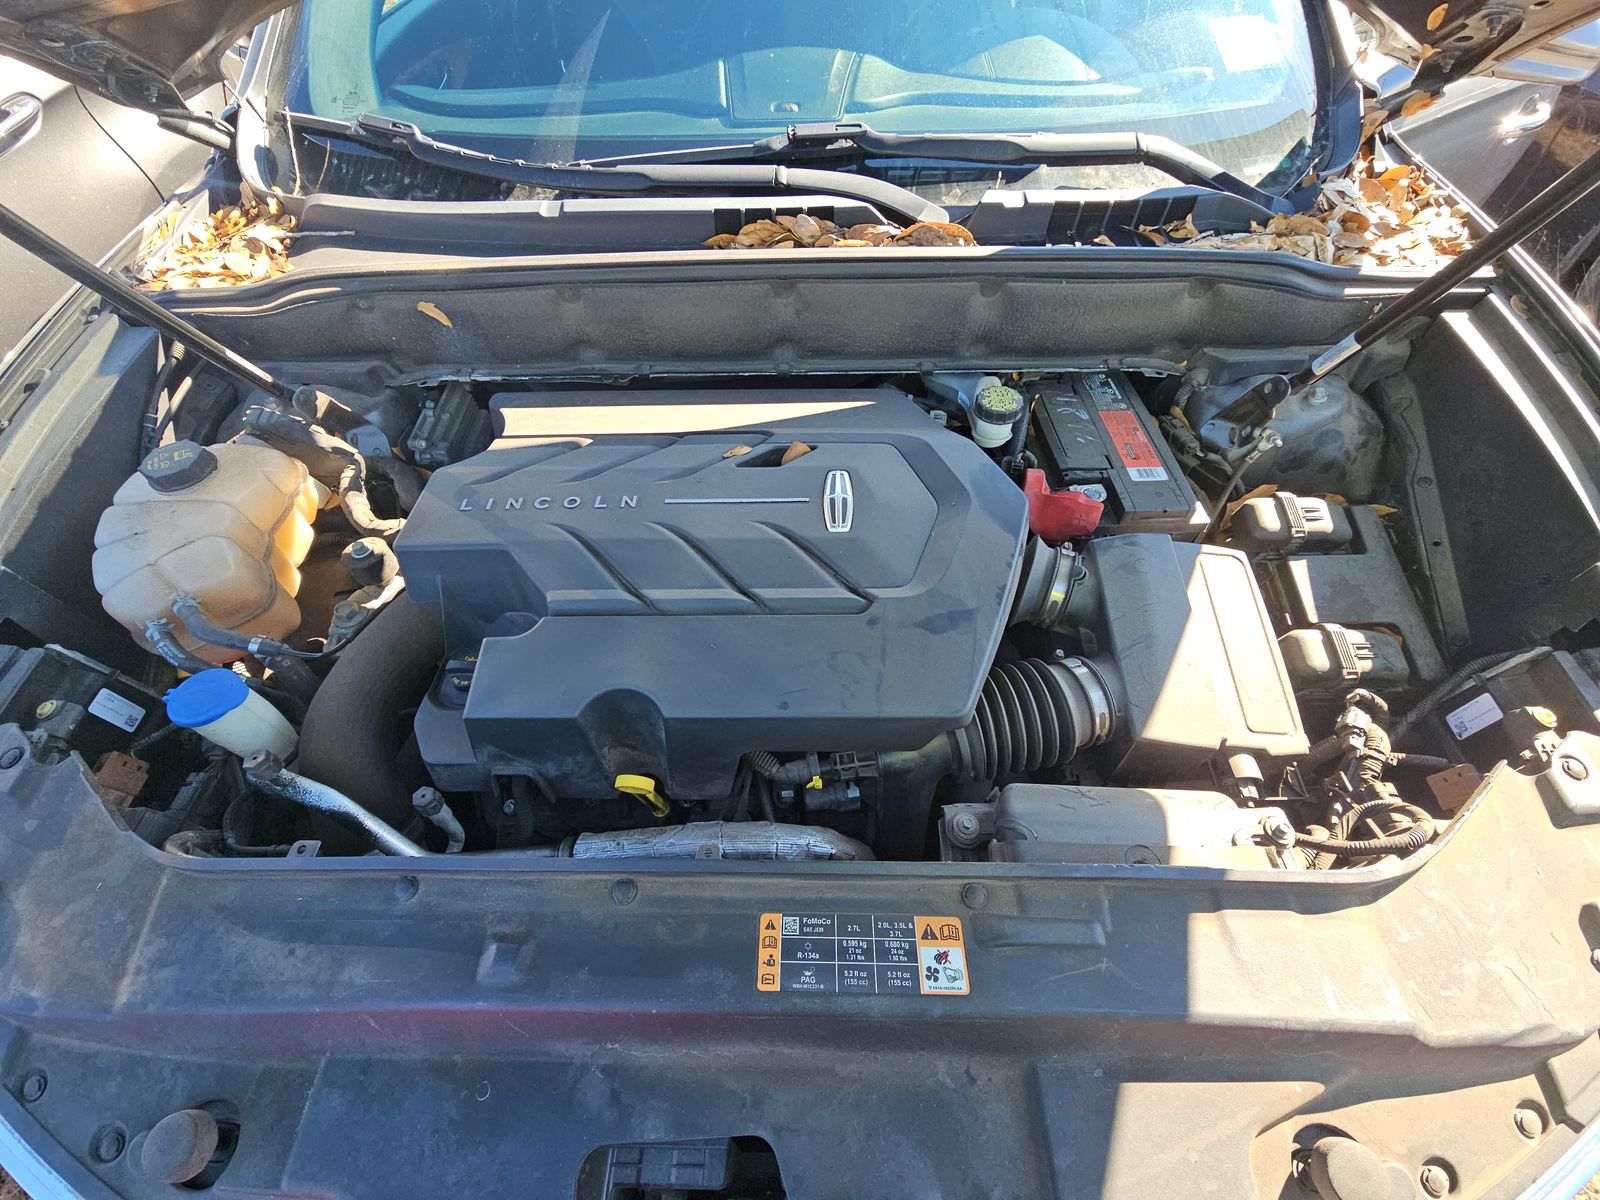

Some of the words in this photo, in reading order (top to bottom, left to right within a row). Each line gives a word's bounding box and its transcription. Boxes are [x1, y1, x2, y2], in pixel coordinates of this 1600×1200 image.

[459, 495, 638, 511] LINCOLN
[803, 917, 831, 925] FoMoCo
[877, 921, 893, 929] 2.0L,
[859, 940, 867, 949] kg
[901, 941, 909, 950] kg
[797, 951, 820, 959] R-134a
[801, 976, 816, 984] PAG
[844, 978, 858, 987] (155
[858, 979, 869, 987] cc)
